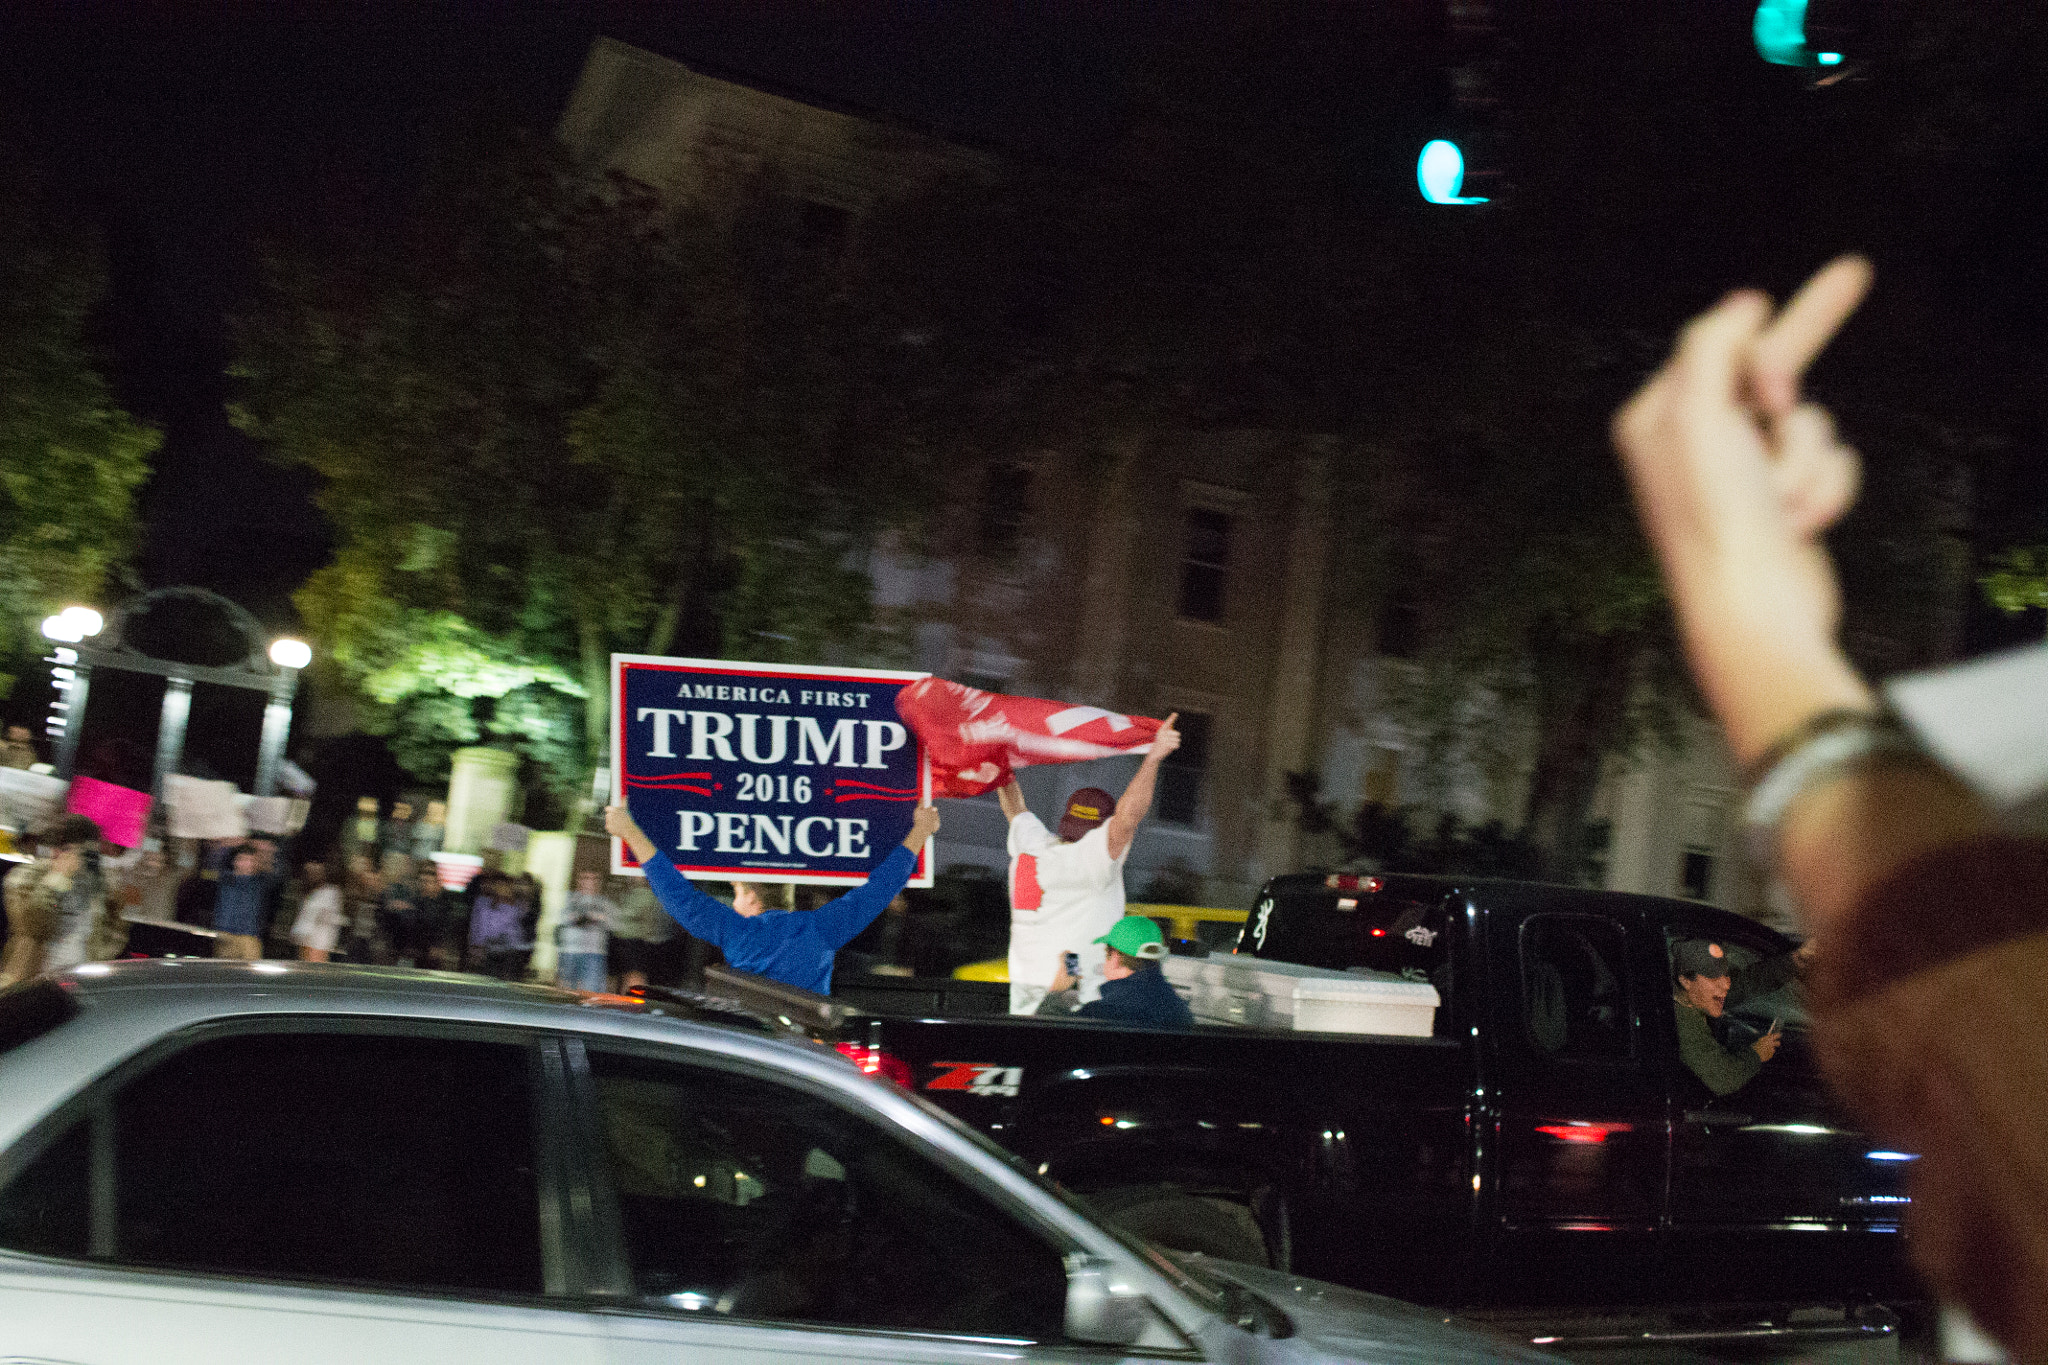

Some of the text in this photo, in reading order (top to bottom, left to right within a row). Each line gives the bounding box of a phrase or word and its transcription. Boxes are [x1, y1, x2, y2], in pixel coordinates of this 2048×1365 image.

[677, 683, 871, 708] AMERICA FIRST
[637, 707, 907, 769] TRUMP
[736, 773, 813, 804] 2016
[676, 810, 871, 858] PENCE
